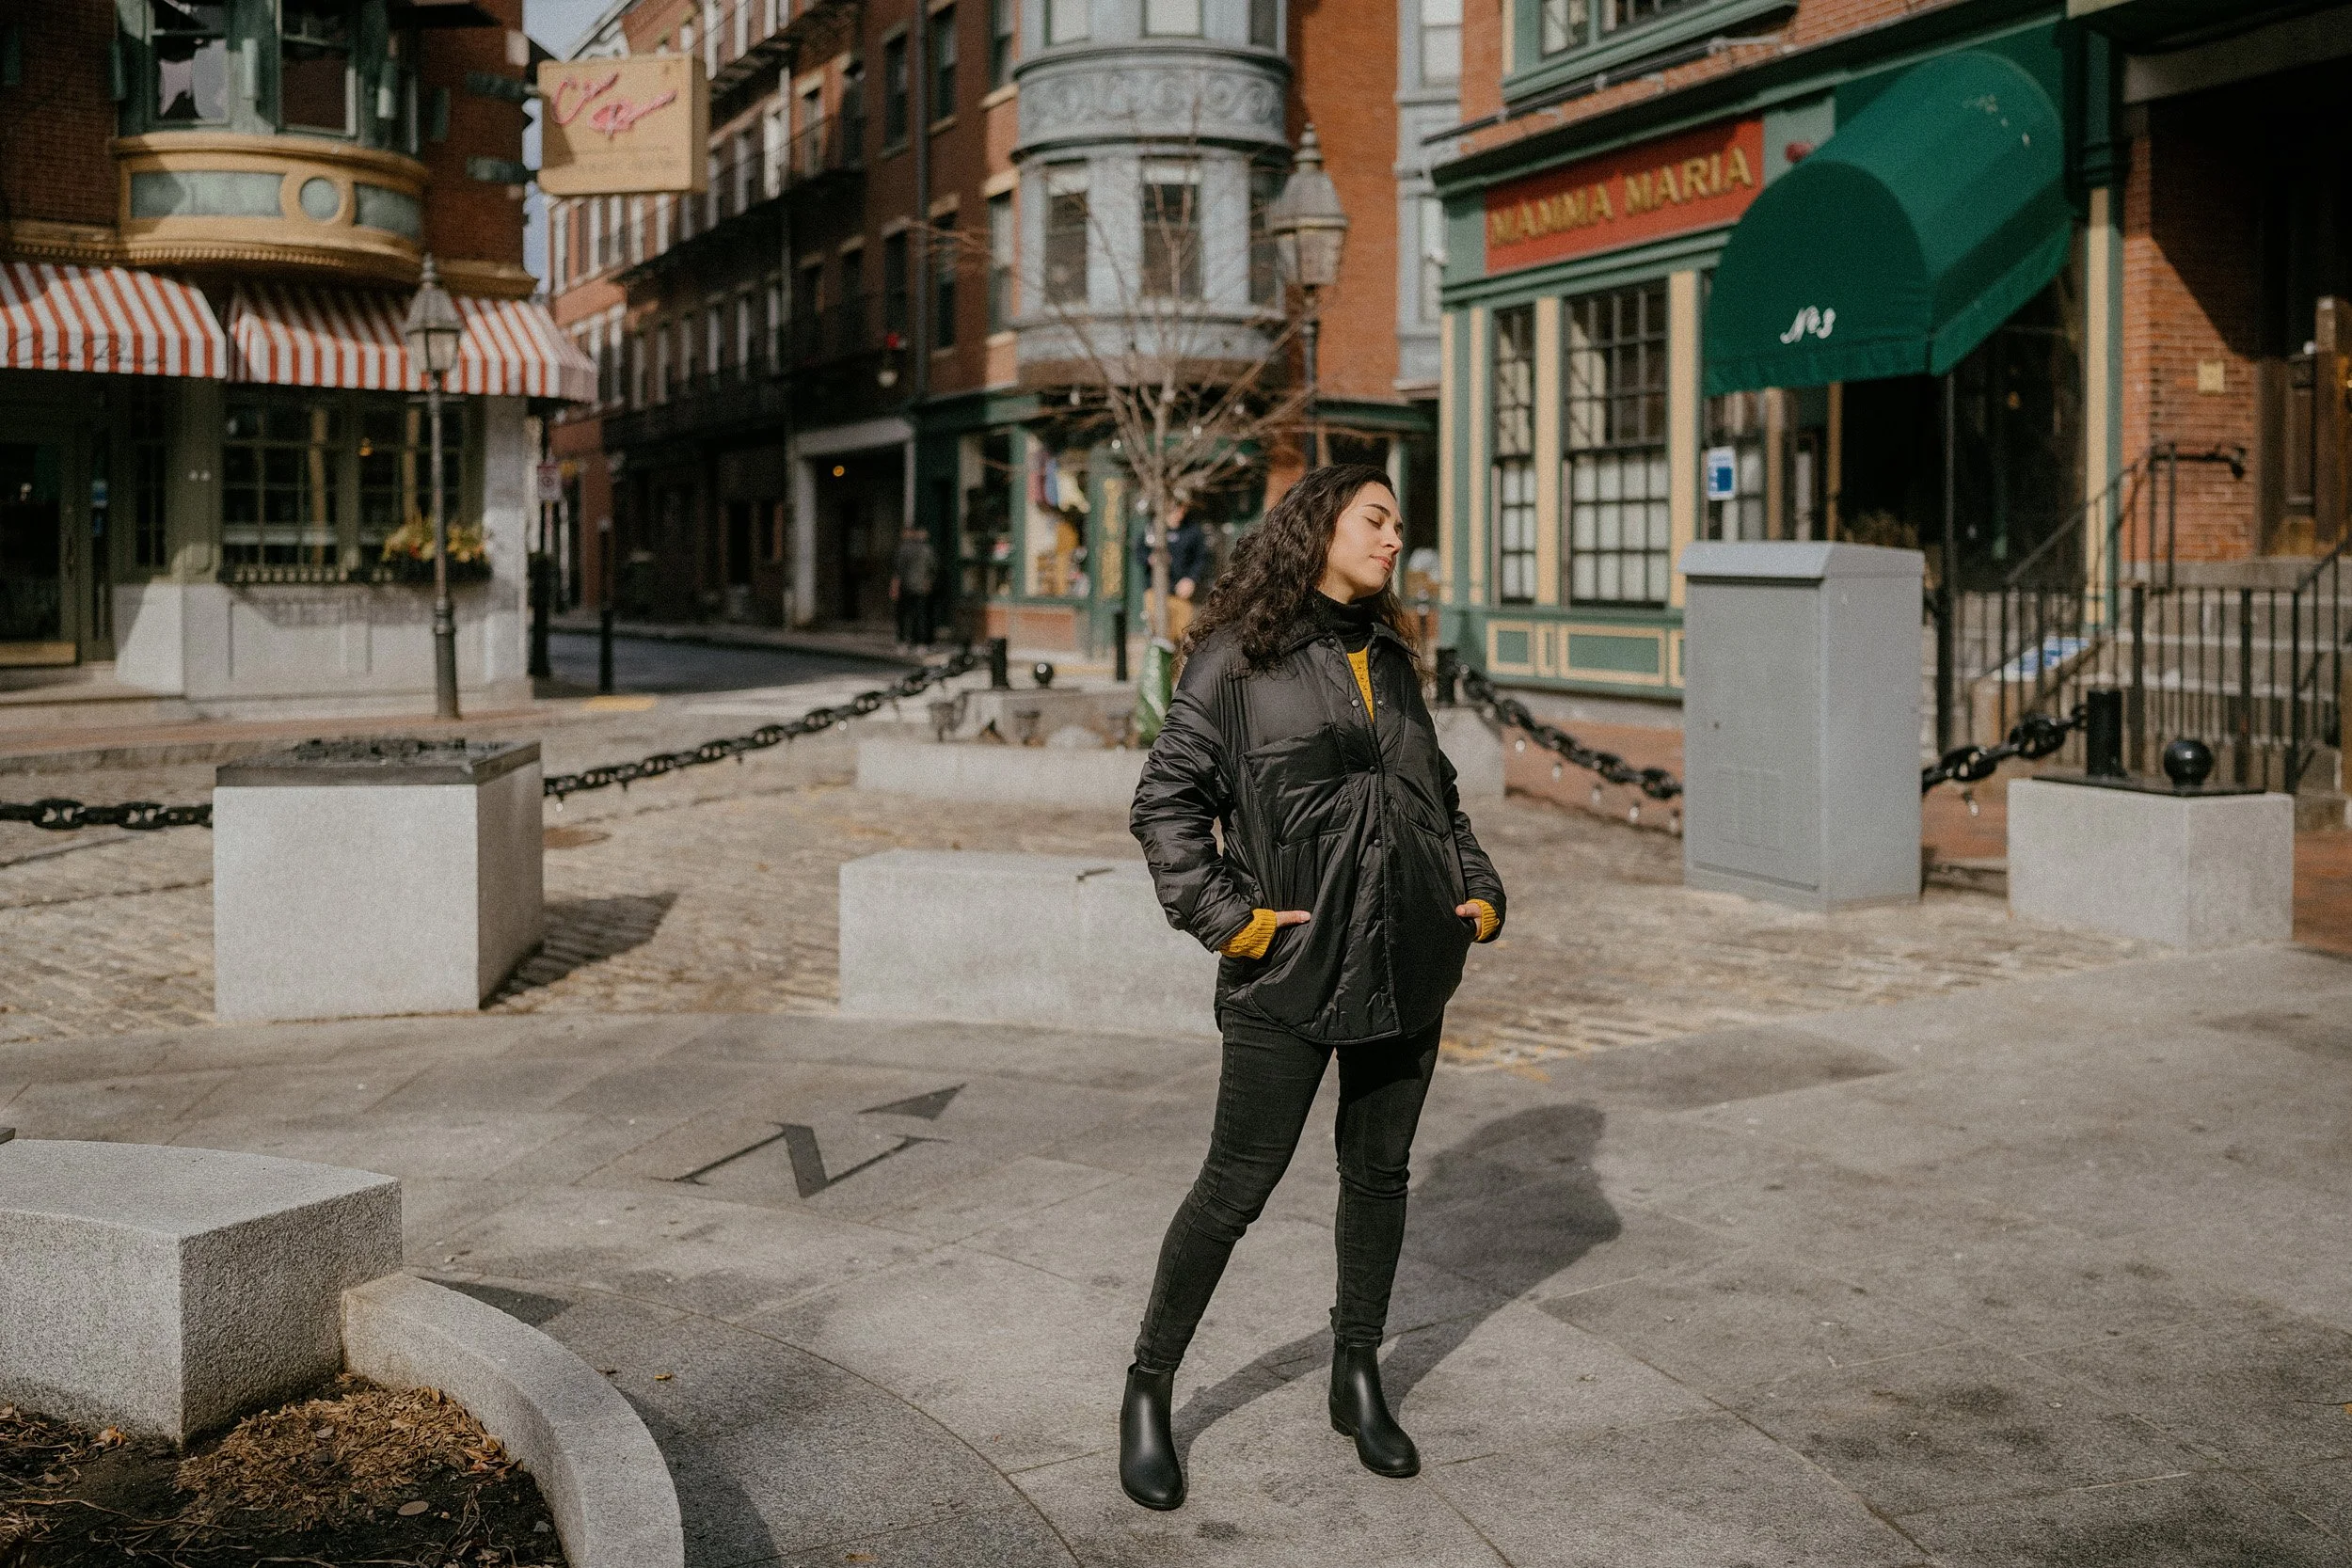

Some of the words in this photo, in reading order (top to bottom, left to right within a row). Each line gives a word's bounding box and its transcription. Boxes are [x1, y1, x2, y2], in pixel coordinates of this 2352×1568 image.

[1489, 182, 1614, 248] MAMMA
[1624, 147, 1754, 216] MARIA
[649, 1119, 952, 1199] N
